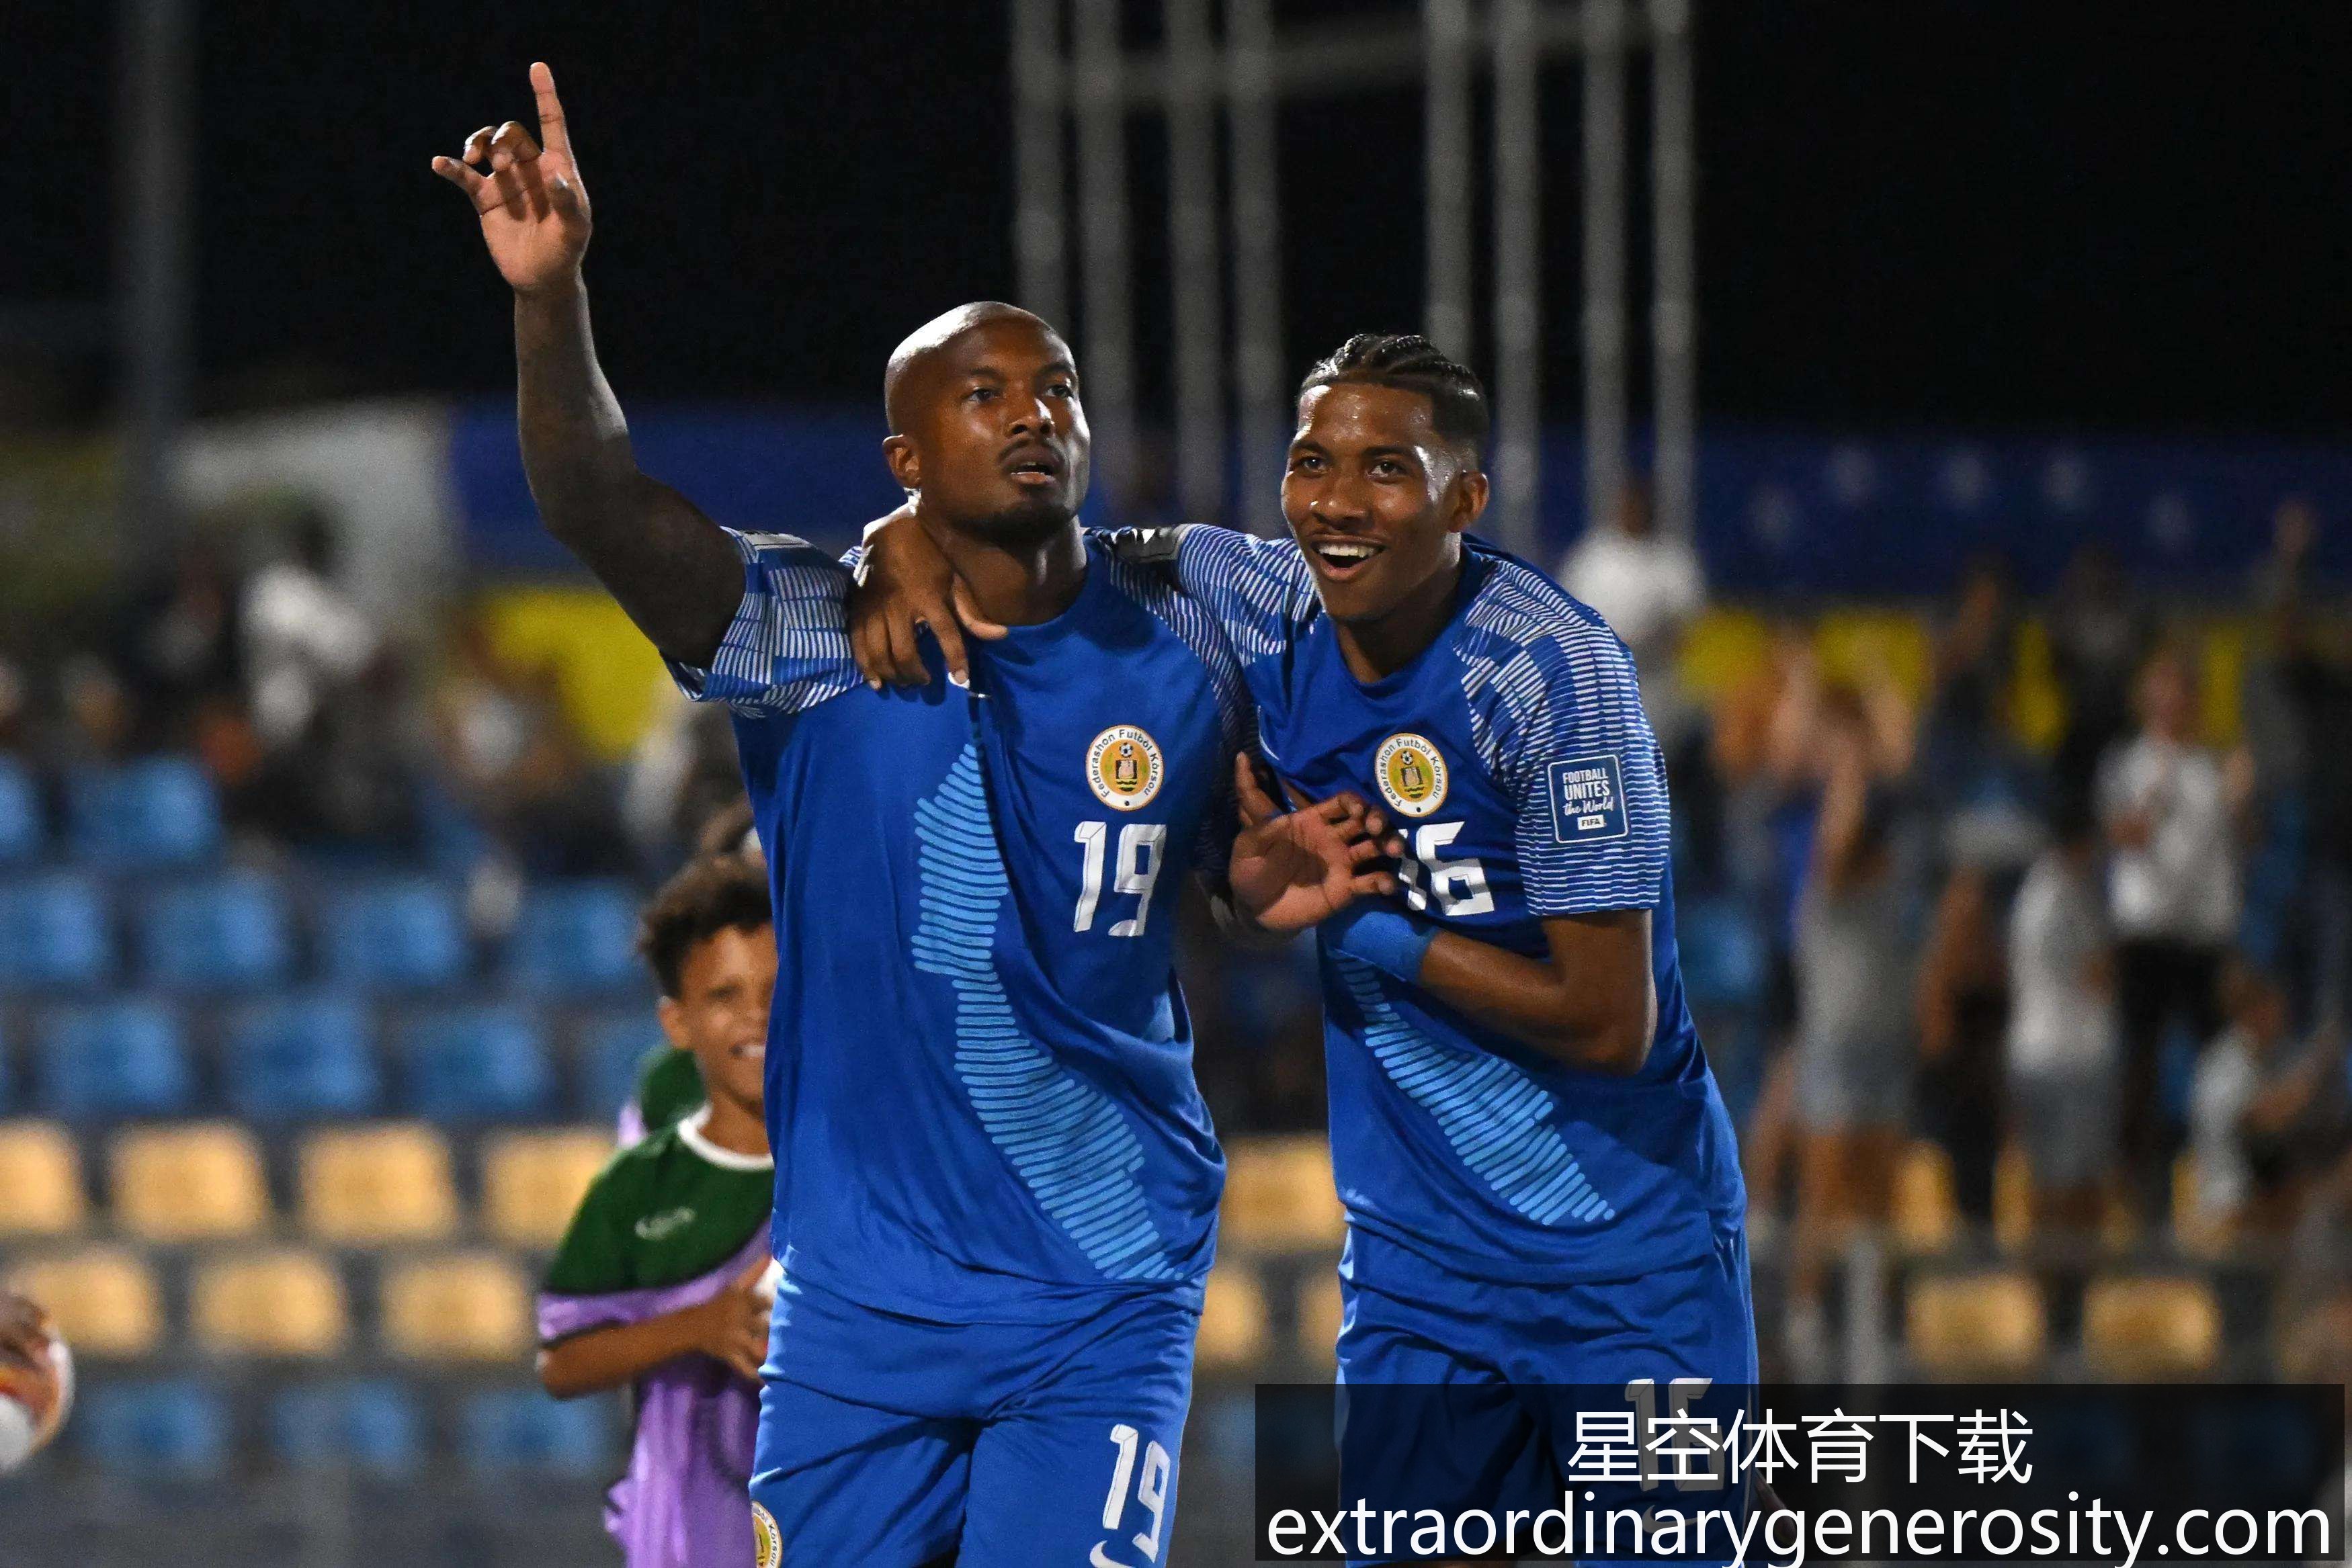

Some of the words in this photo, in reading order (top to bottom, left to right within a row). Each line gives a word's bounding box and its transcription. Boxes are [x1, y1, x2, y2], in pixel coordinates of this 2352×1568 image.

[1091, 734, 1116, 798] Federashon
[1379, 744, 1403, 807] Federashon
[1562, 768, 1608, 784] FOOTBALL
[1564, 780, 1610, 801] UNITES
[1562, 801, 1582, 816] the
[1582, 796, 1614, 814] World
[1581, 818, 1601, 826] FIFA
[1073, 820, 1167, 937] 19
[1624, 1377, 1726, 1492] 16
[1102, 1423, 1171, 1564] 19
